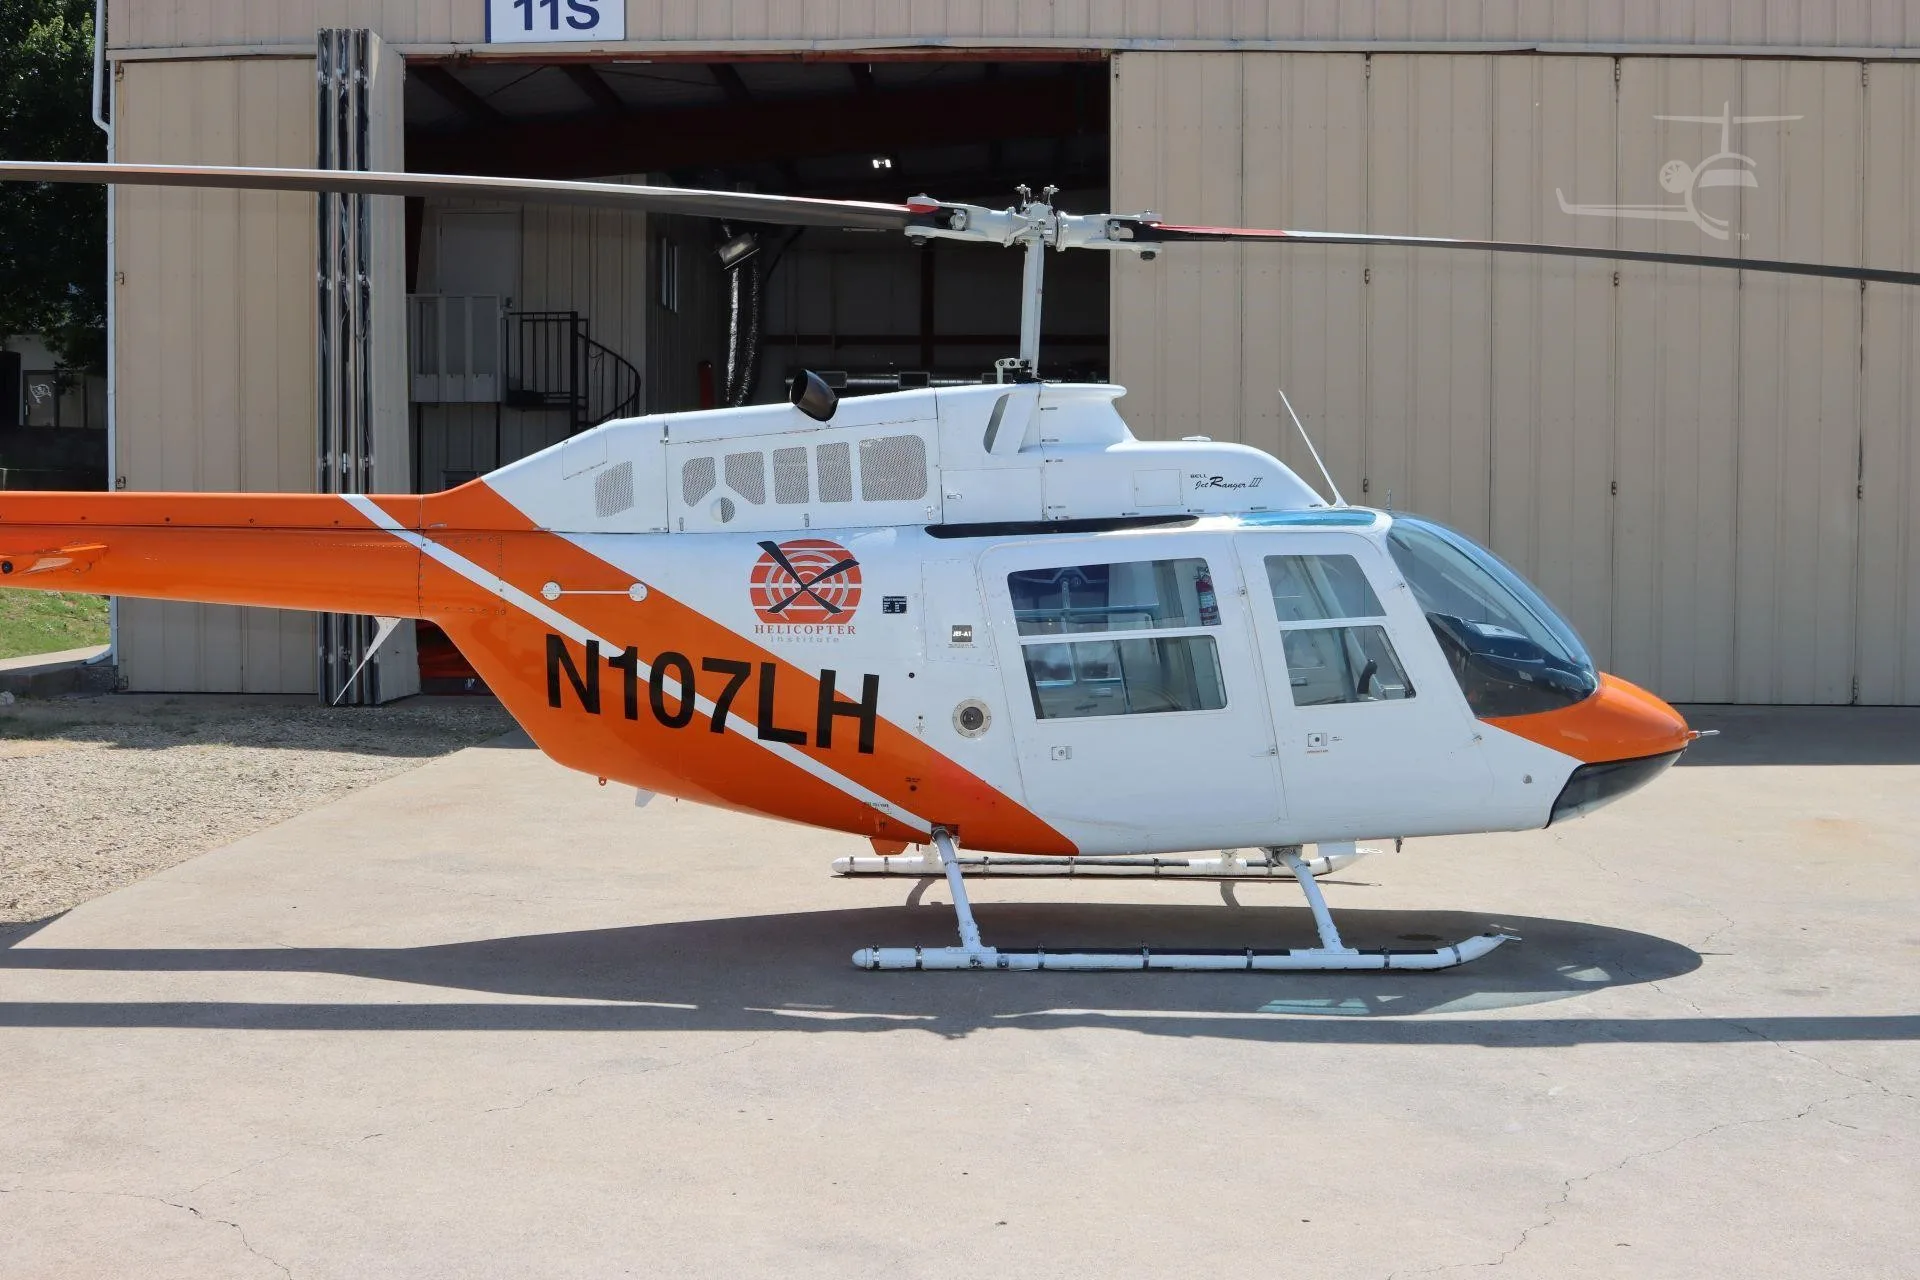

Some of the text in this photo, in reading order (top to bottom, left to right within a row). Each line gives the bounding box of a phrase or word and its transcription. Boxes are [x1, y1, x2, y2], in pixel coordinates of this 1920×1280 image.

[513, 0, 600, 31] 11S
[754, 624, 857, 635] HELICOPTER
[546, 633, 880, 755] N107LH
